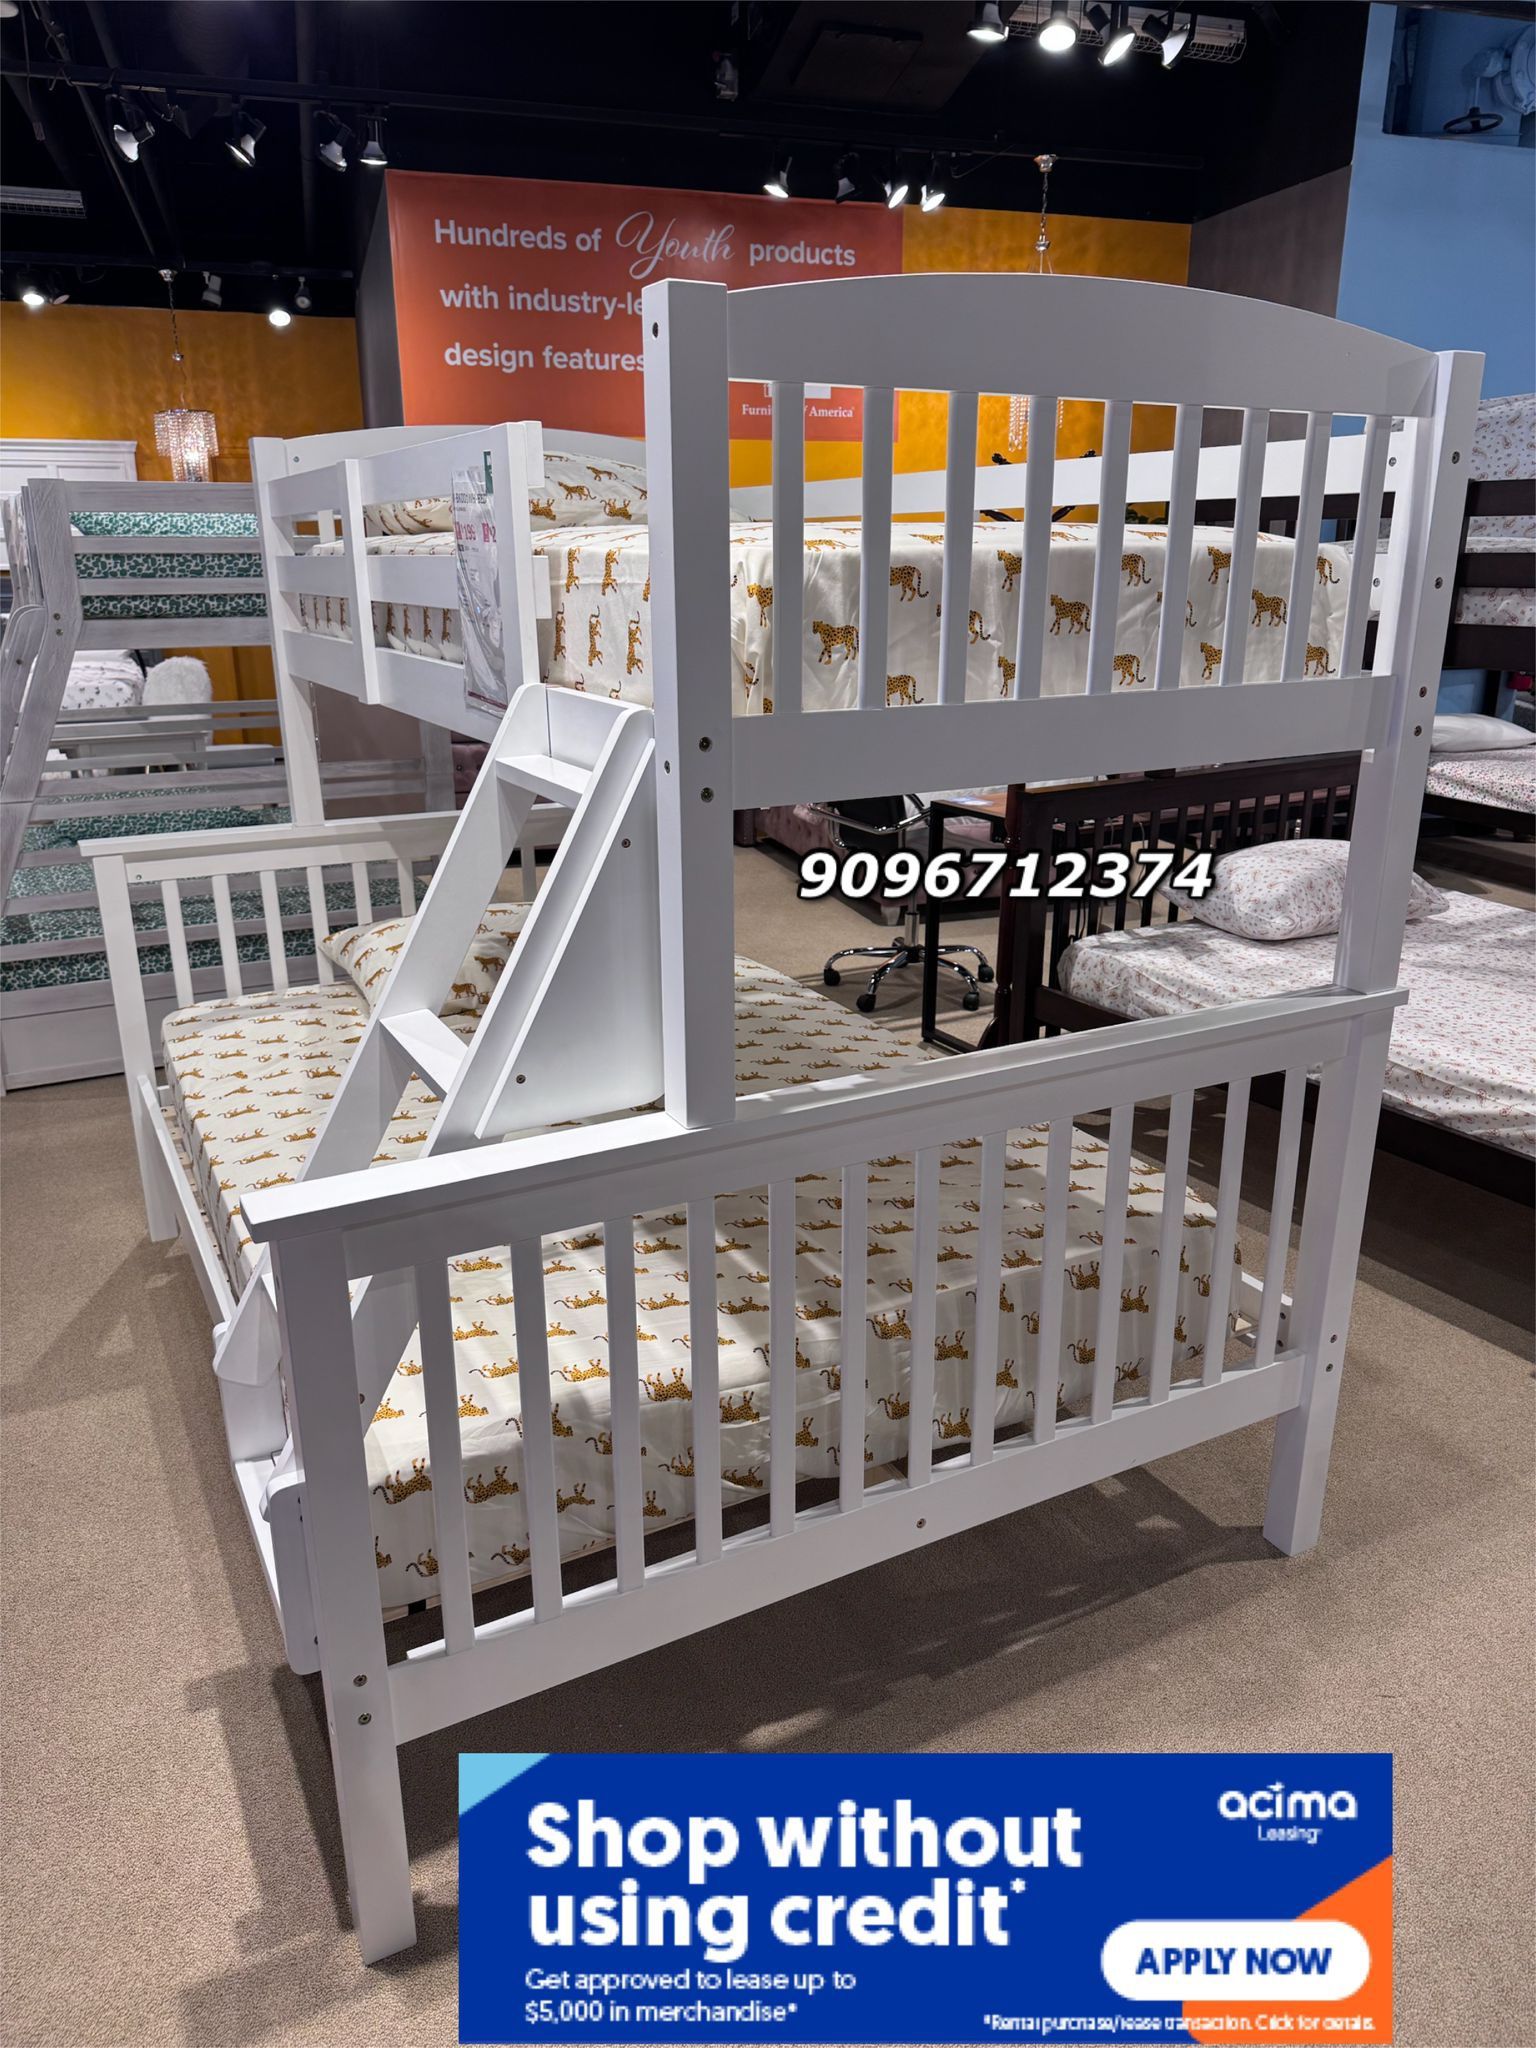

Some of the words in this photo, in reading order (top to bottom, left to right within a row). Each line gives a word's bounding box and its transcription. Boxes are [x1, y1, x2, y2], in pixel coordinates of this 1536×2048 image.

[434, 218, 568, 252] Hundreds
[575, 225, 603, 253] of
[615, 210, 736, 280] Youth
[749, 241, 857, 268] products
[439, 282, 500, 311] with
[507, 284, 643, 321] industry-le
[443, 342, 534, 375] design
[541, 345, 644, 373] features
[741, 403, 773, 417] Furni
[808, 406, 854, 418] America
